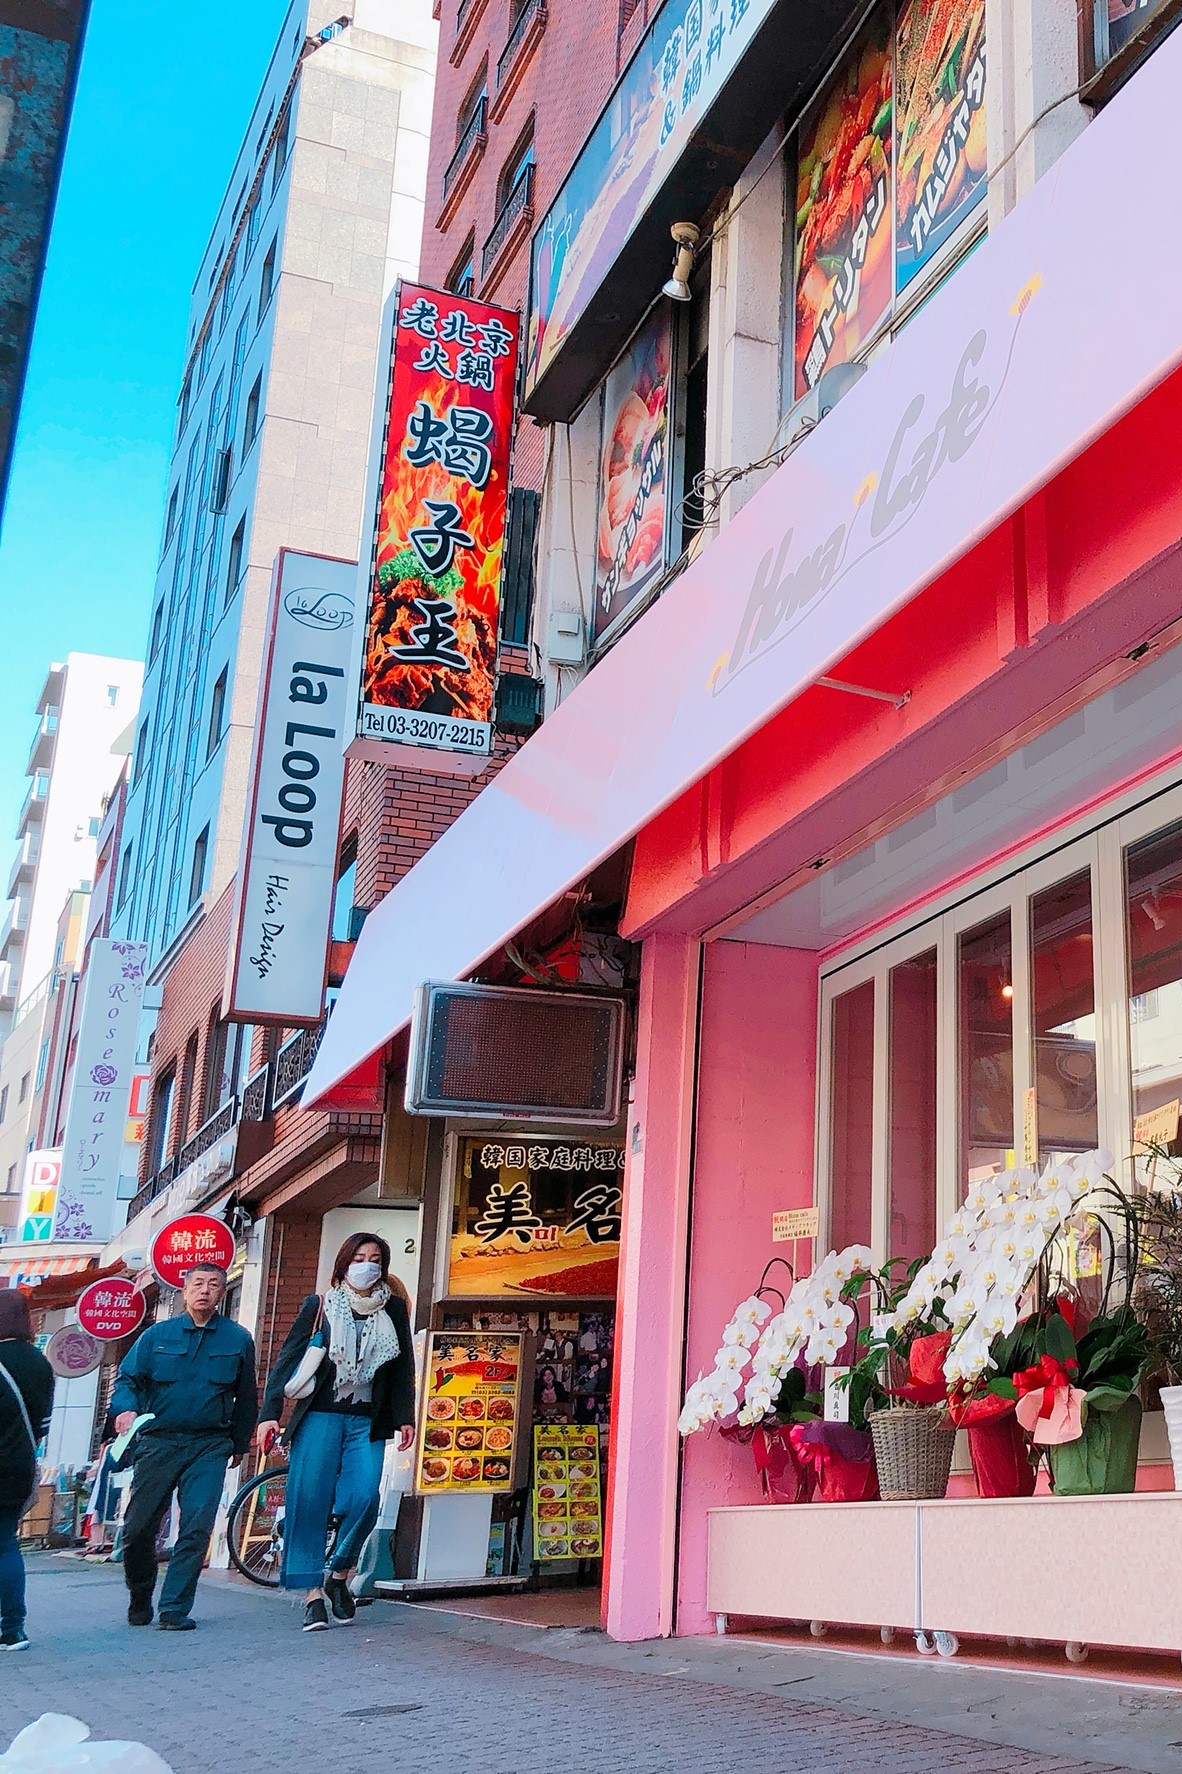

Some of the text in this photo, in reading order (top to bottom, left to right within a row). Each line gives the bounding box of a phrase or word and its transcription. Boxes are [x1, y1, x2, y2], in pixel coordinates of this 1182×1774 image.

[400, 298, 513, 357] 老北京
[413, 342, 495, 391] 火鍋
[366, 713, 485, 748] Tel 03-3207-2215
[261, 660, 345, 849] la Loop
[249, 874, 289, 982] Hair Design
[171, 1230, 216, 1252] 韓流
[404, 1238, 415, 1254] 2
[162, 1251, 225, 1265] 韓國文化空間
[94, 1291, 132, 1308] 韓流
[96, 1322, 122, 1330] DVD
